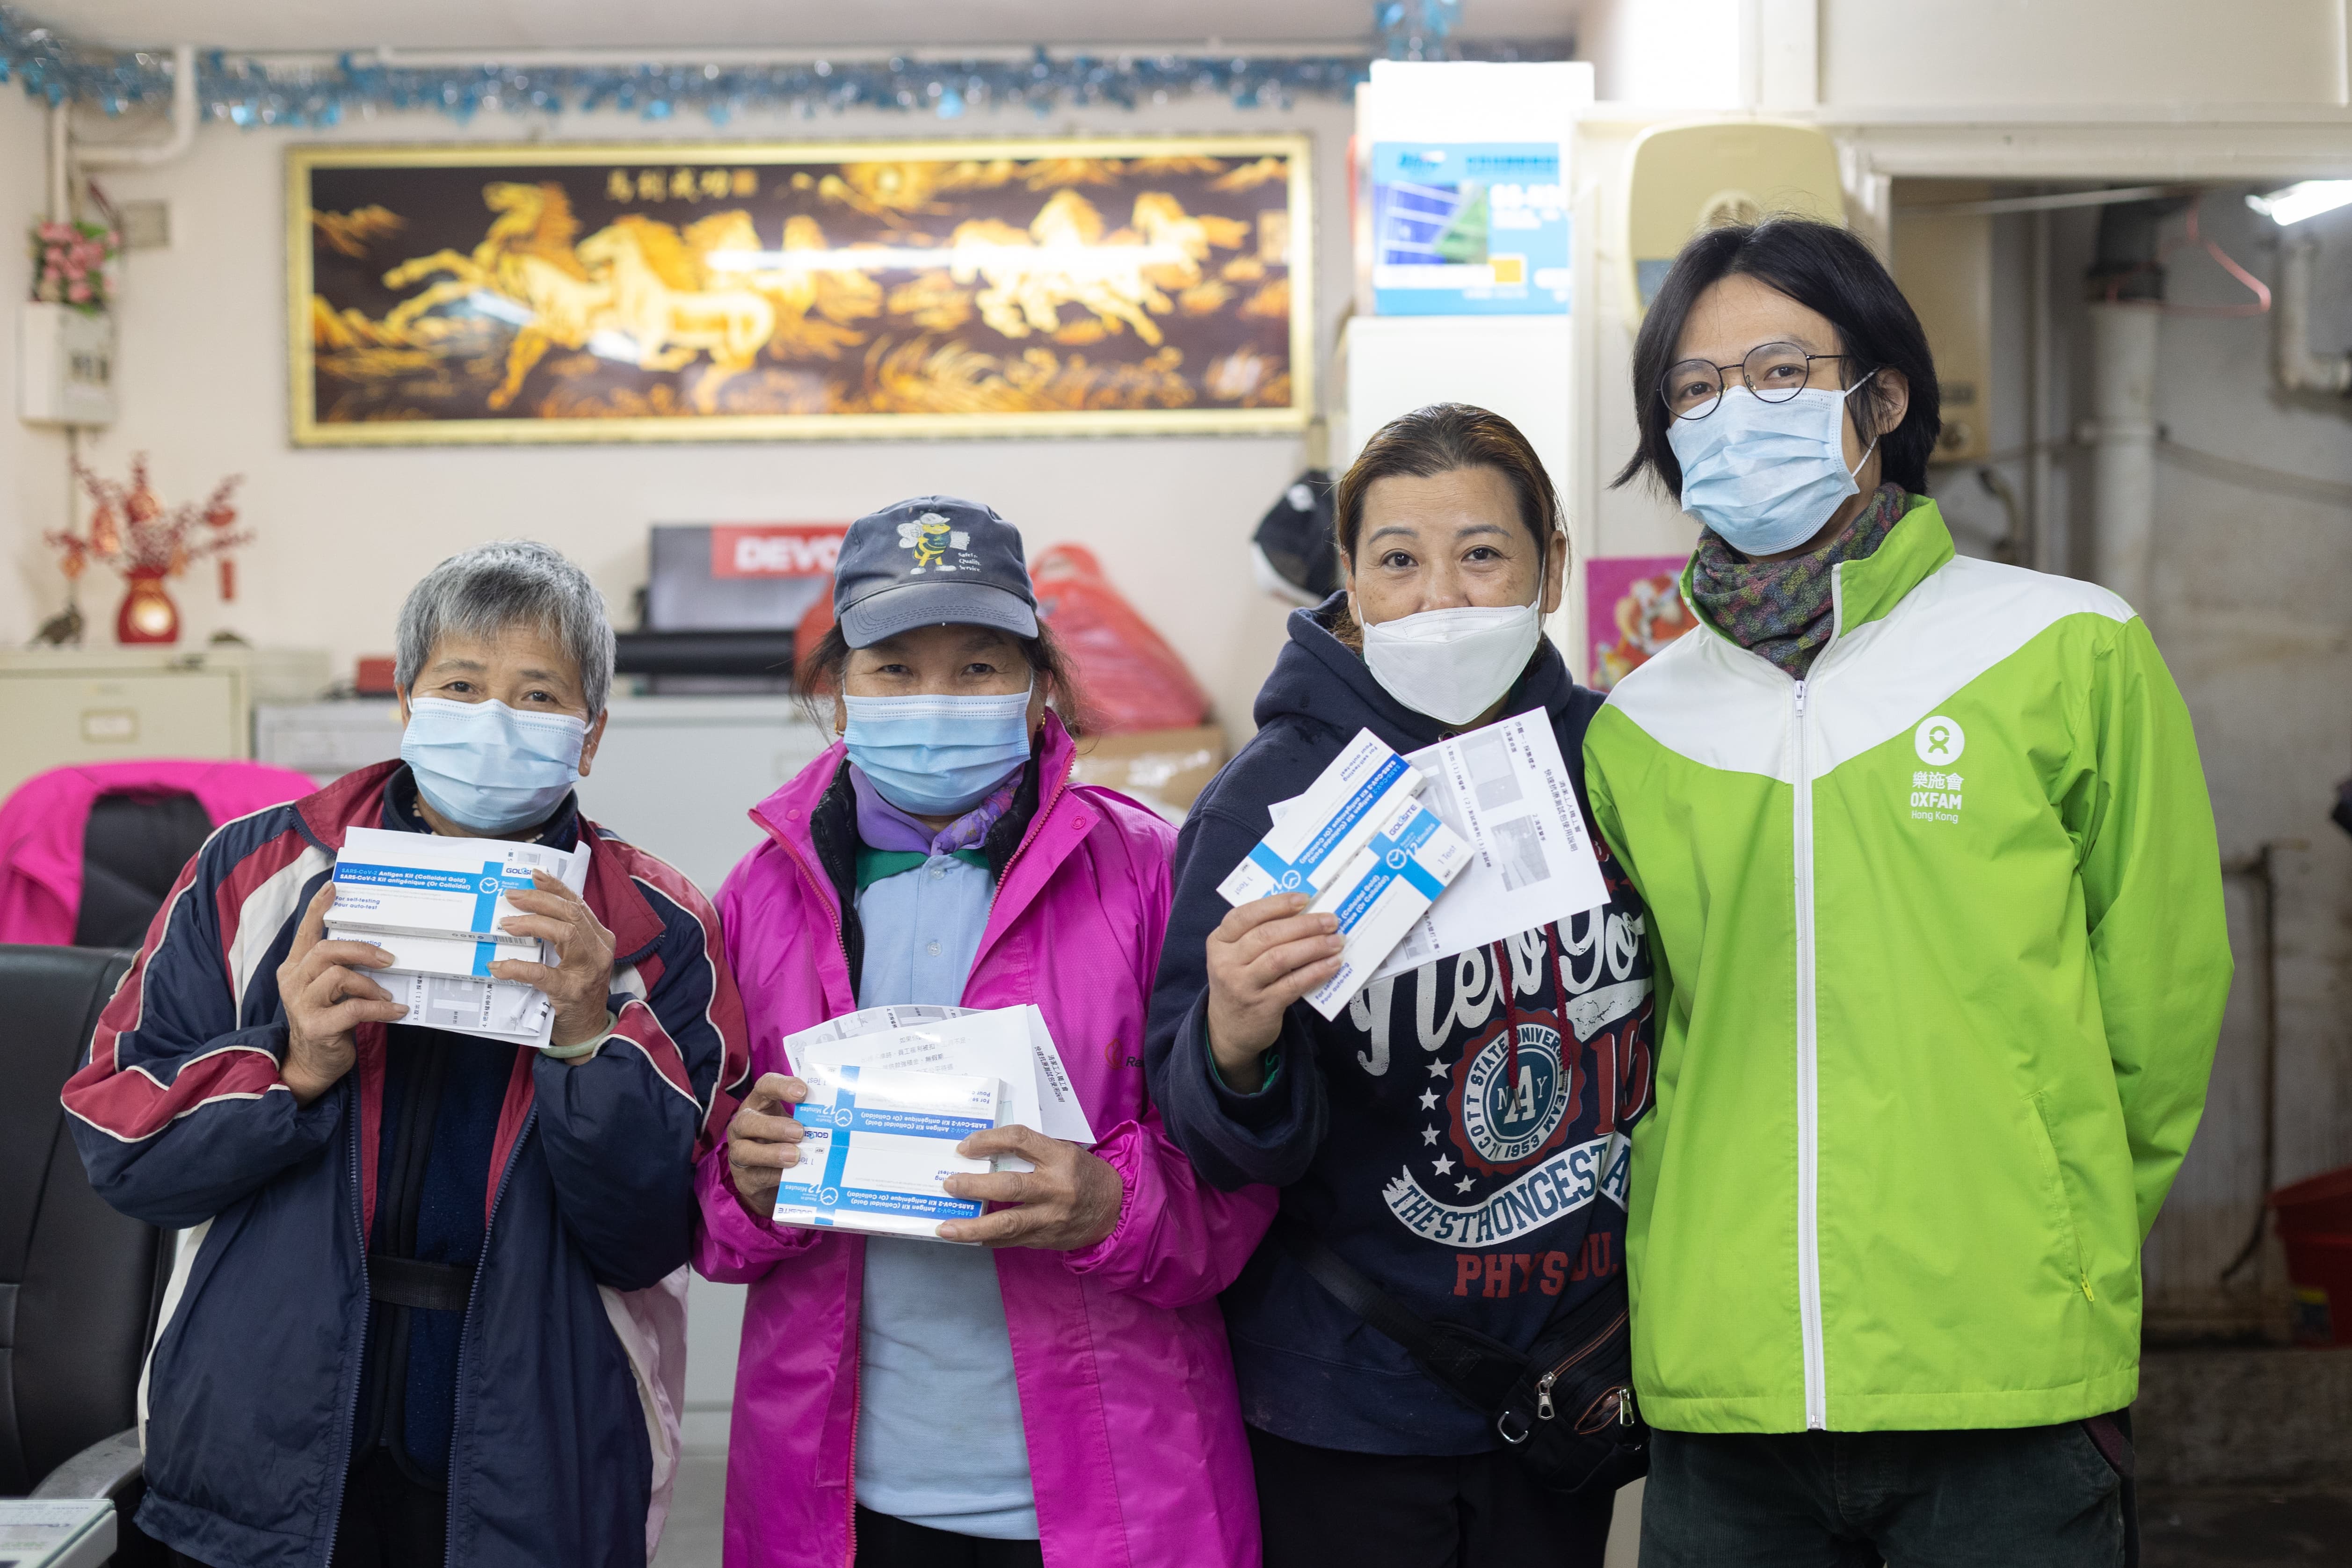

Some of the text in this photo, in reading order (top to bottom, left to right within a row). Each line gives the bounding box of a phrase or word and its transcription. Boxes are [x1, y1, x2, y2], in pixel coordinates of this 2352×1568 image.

[1339, 741, 1372, 777] Pour auto-test
[1342, 746, 1377, 782] For self-testing
[1366, 759, 1396, 791] SARS-CoV-2
[1912, 771, 1964, 791] 樂施會
[1359, 788, 1369, 799] Kit
[1910, 792, 1962, 810] OXFAM
[1306, 763, 1401, 864] SARS-CoV-2 Antigen Kit (Colloidal Gold)
[1330, 795, 1362, 829] antigénique
[1543, 769, 1578, 852] 快速抗原測試包使用說明
[1911, 810, 1959, 824] Hong Kong
[1321, 827, 1334, 838] (Or
[341, 867, 377, 876] SARS-CoV-2
[415, 873, 446, 882] (Colloidal
[387, 877, 425, 887] antigénique
[439, 881, 471, 890] Colloïdal)
[1341, 873, 1381, 920] (Colloidal Gold)
[1320, 967, 1353, 1005] Pour auto-test
[1471, 1037, 1509, 1086] STATE
[1034, 1045, 1065, 1104] 快速抗原測試包使用說明
[1047, 1053, 1069, 1093] 清潔工人職工會
[1537, 1076, 1548, 1098] Y
[822, 1104, 835, 1115] 12
[860, 1111, 890, 1121] Colloïdal)
[883, 1120, 915, 1129] (Colloidal
[904, 1116, 940, 1125] antigénique
[951, 1120, 987, 1129] SARS-CoV-2
[1504, 1134, 1540, 1158] 1953
[808, 1183, 821, 1194] 12
[846, 1191, 877, 1200] Colloïdal)
[869, 1200, 900, 1209] (Colloidal
[890, 1195, 927, 1205] antigénique
[938, 1200, 974, 1209] SARS-CoV-2
[937, 1207, 973, 1216] SARS-CoV-2
